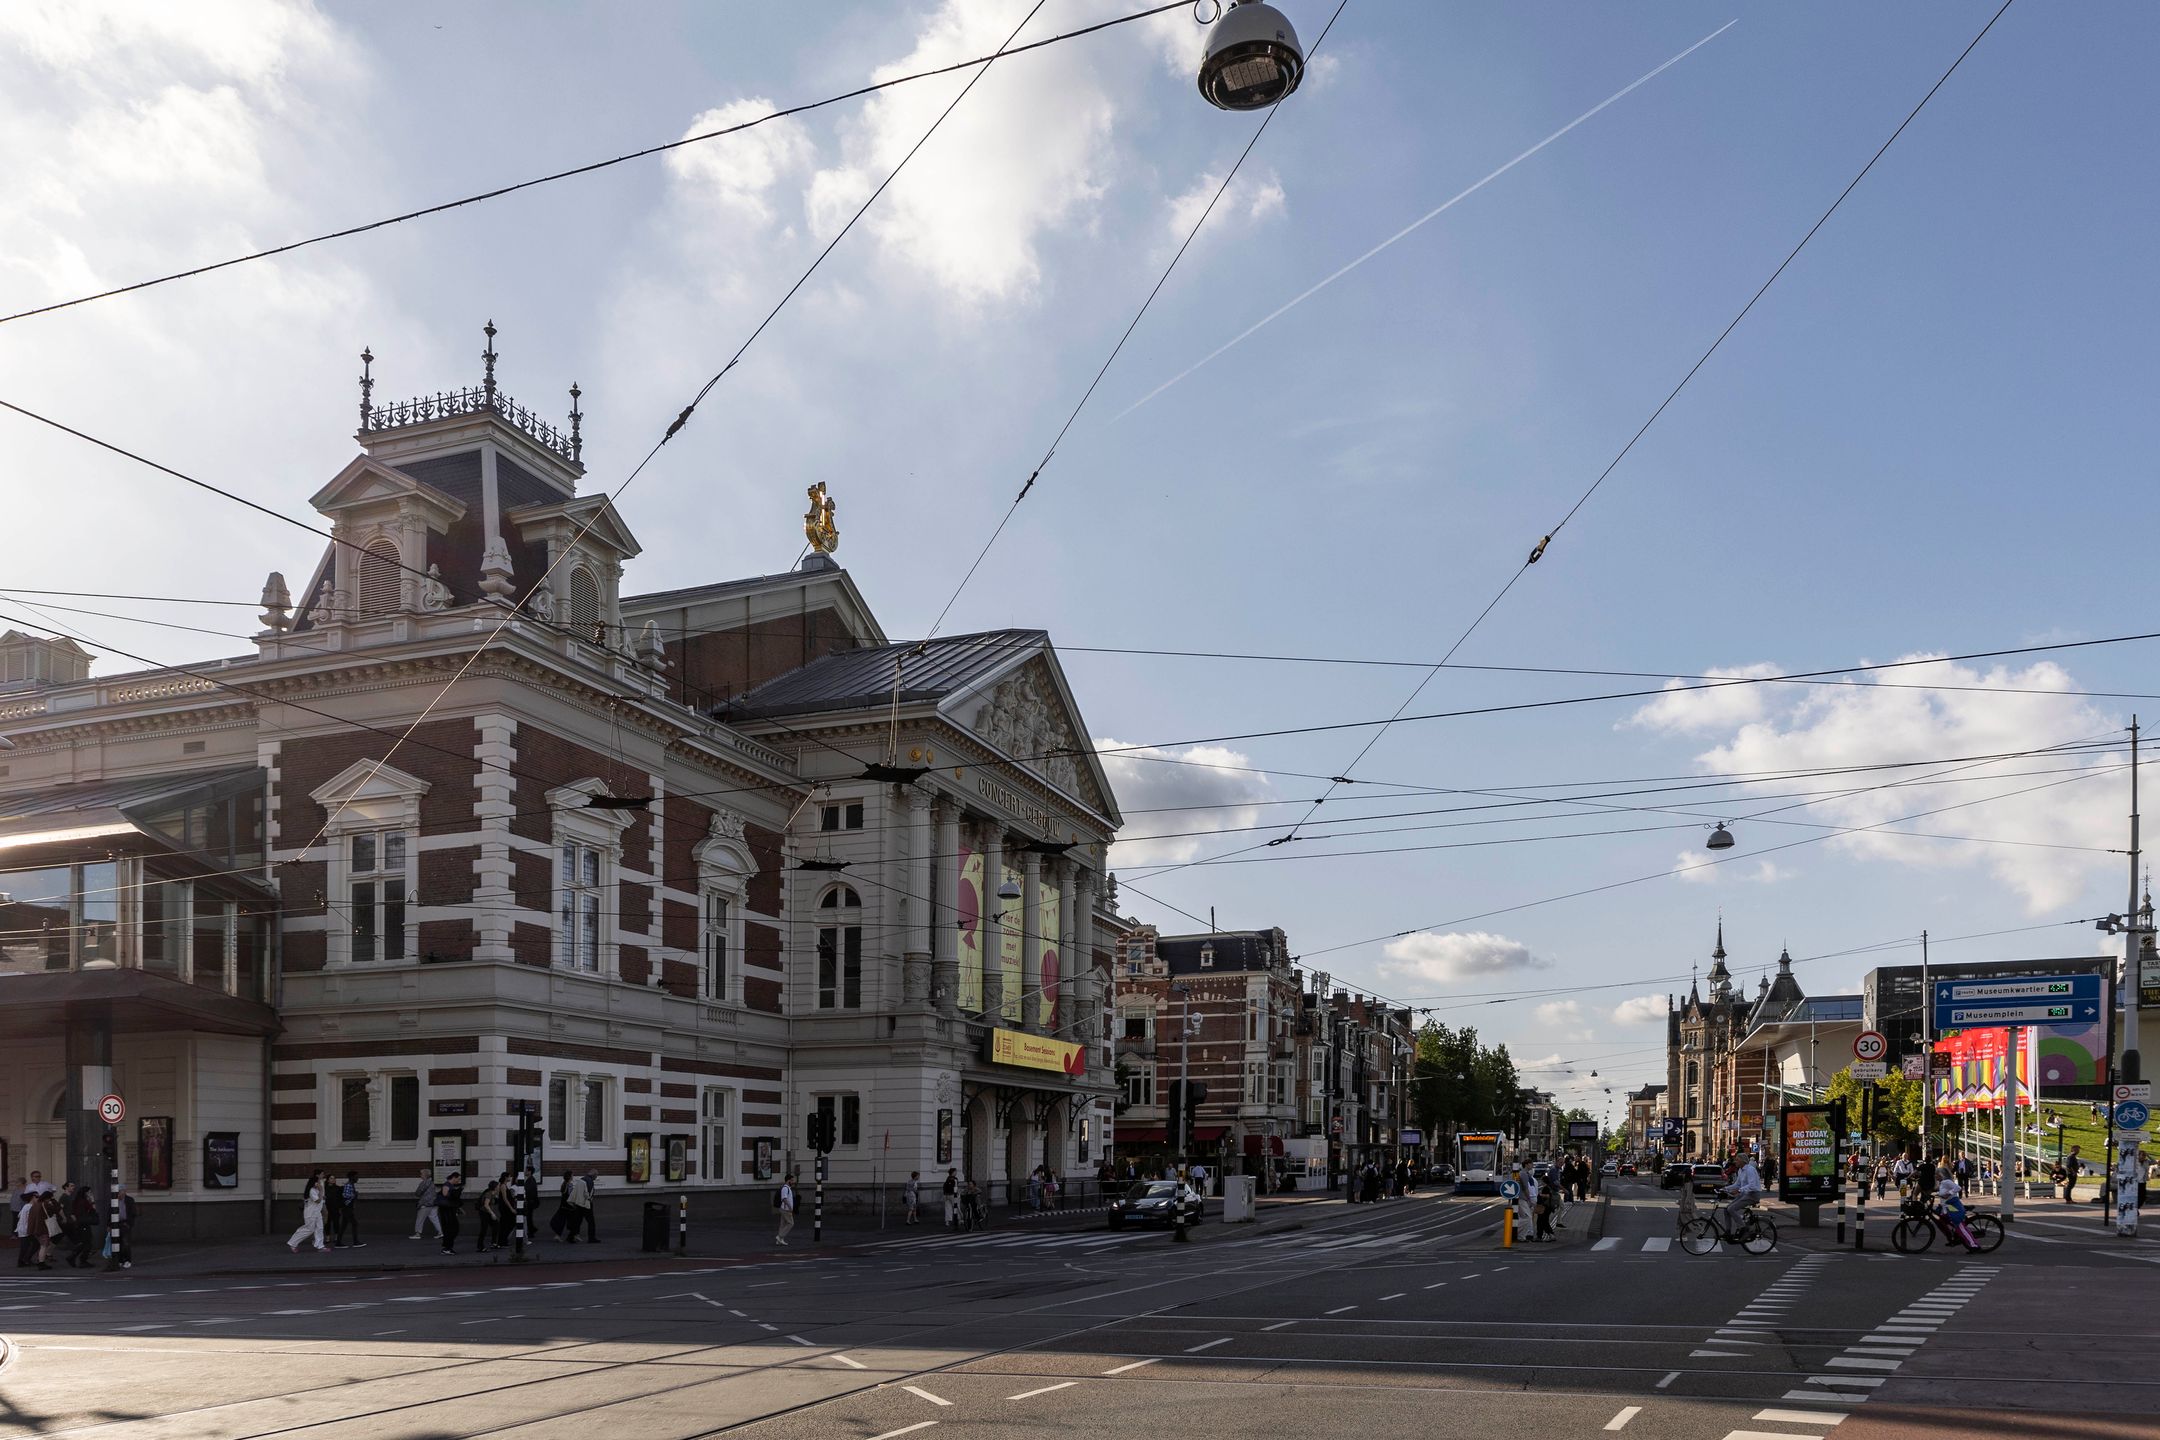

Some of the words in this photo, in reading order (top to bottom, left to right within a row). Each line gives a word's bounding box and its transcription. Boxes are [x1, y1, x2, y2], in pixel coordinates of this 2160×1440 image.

[1976, 986, 2045, 995] Museumkwartier
[1966, 1010, 2024, 1019] Museumplein
[1859, 1040, 1881, 1052] 30
[104, 1103, 120, 1114] 30
[1664, 1121, 1674, 1135] P
